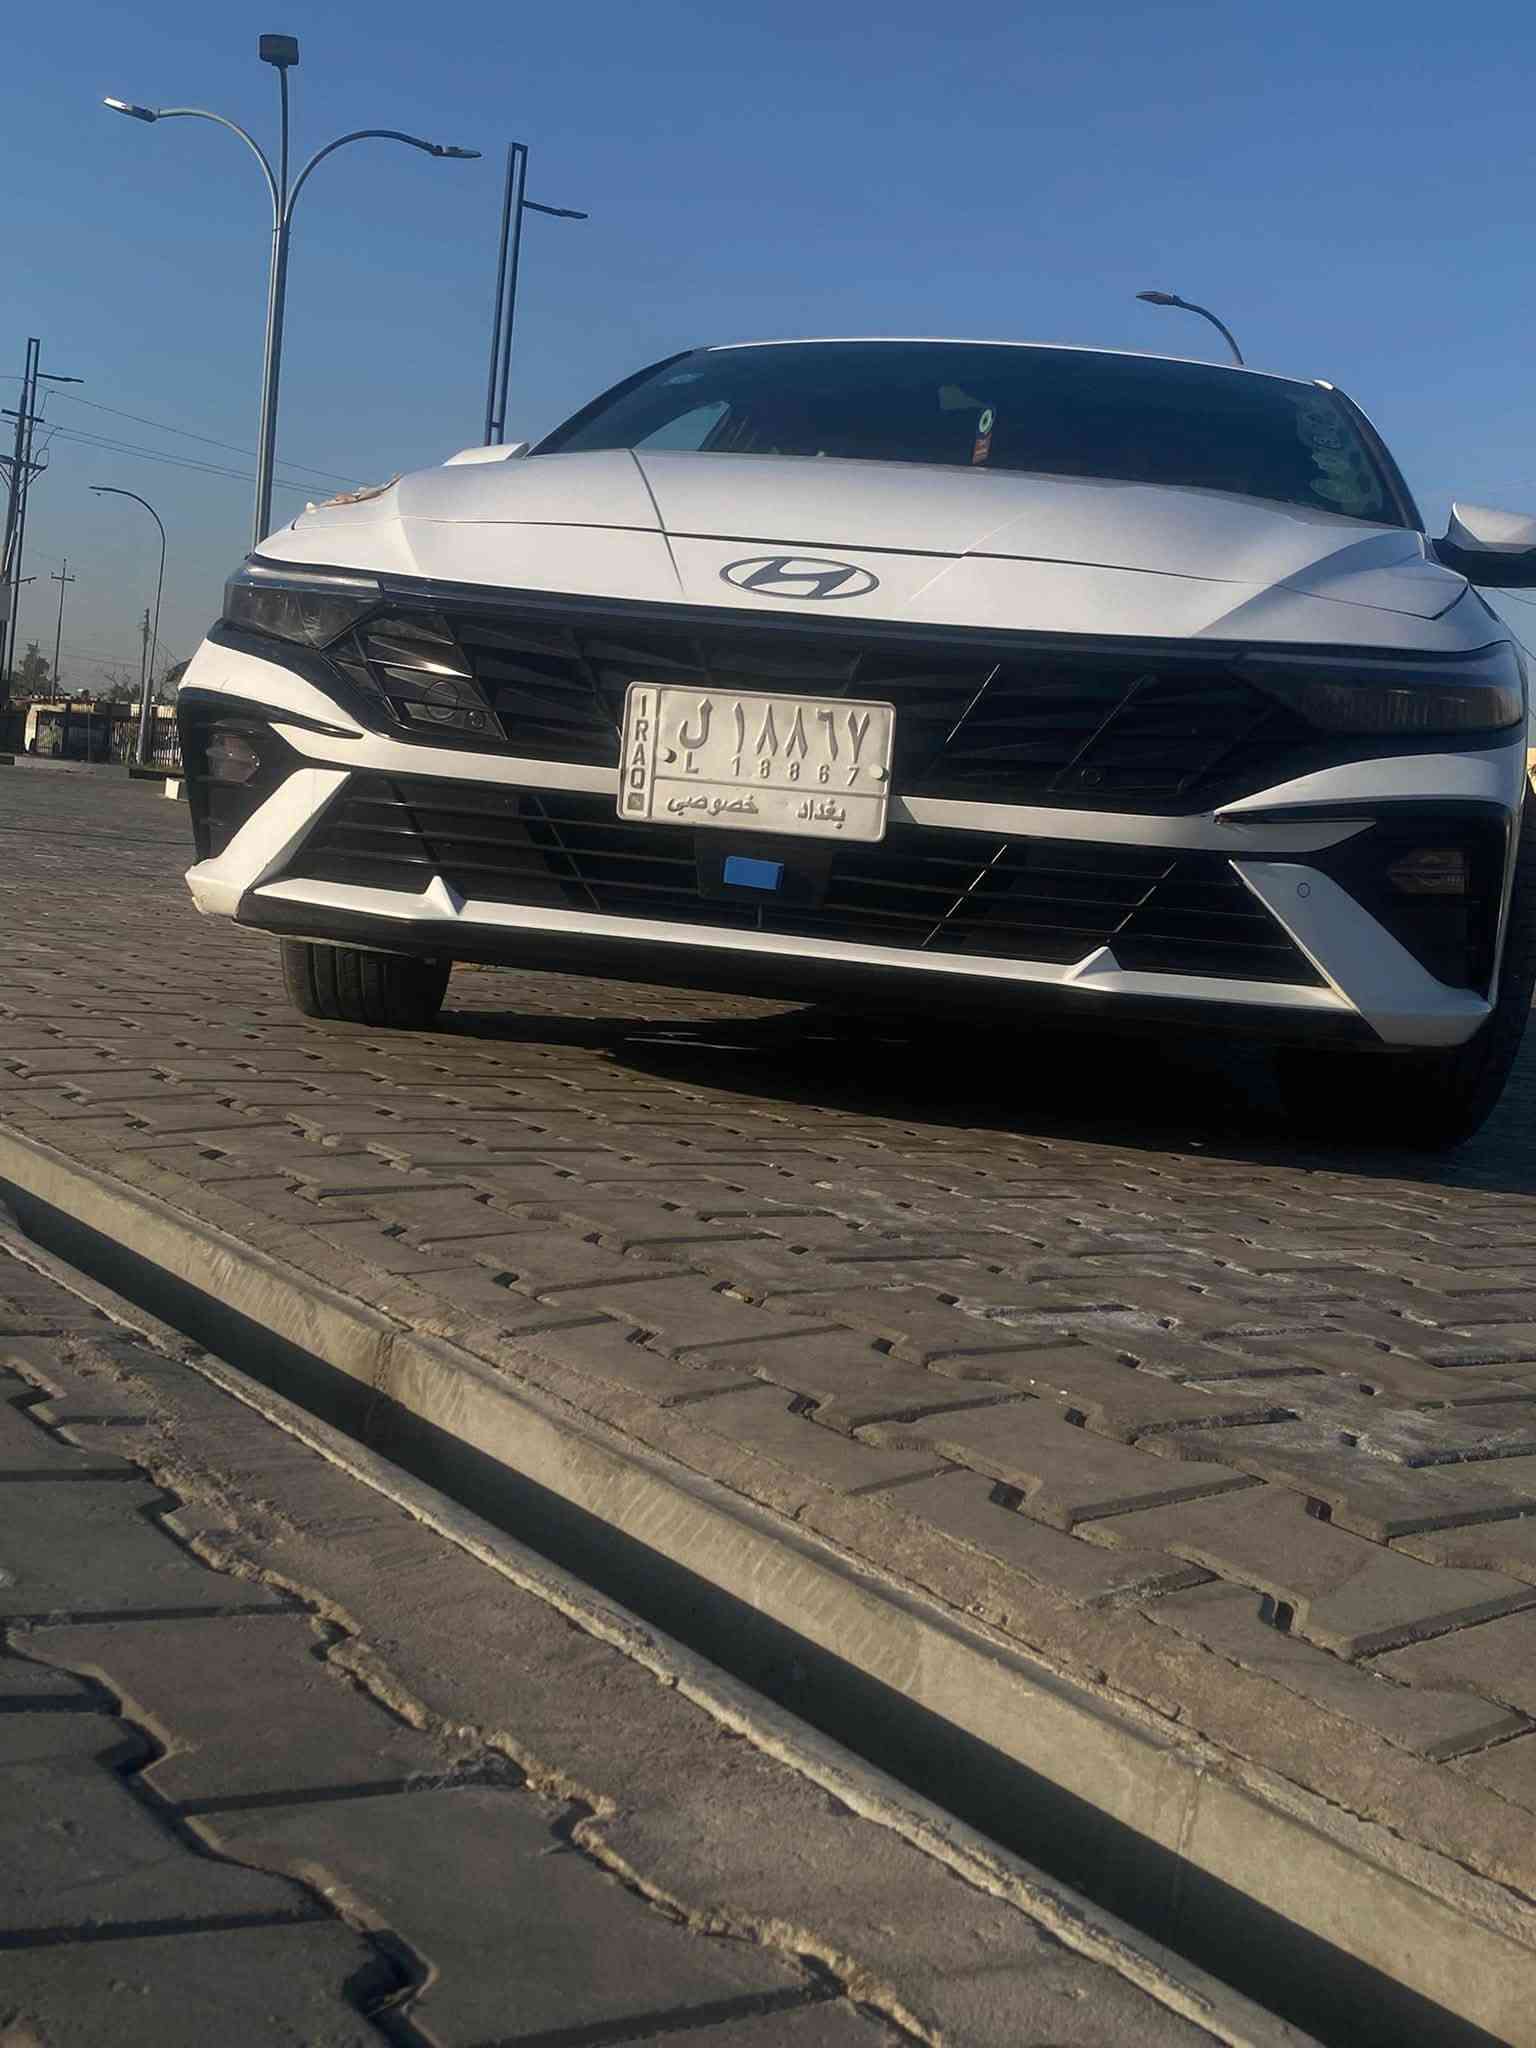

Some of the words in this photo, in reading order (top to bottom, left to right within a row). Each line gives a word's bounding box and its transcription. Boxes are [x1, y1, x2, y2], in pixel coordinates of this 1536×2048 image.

[630, 694, 648, 790] IRAQ
[732, 701, 870, 764] ١٨٨٦٧
[684, 751, 700, 774] L
[730, 755, 860, 787] 18867
[667, 793, 759, 817] خصوصي
[796, 798, 847, 830] بغداد
